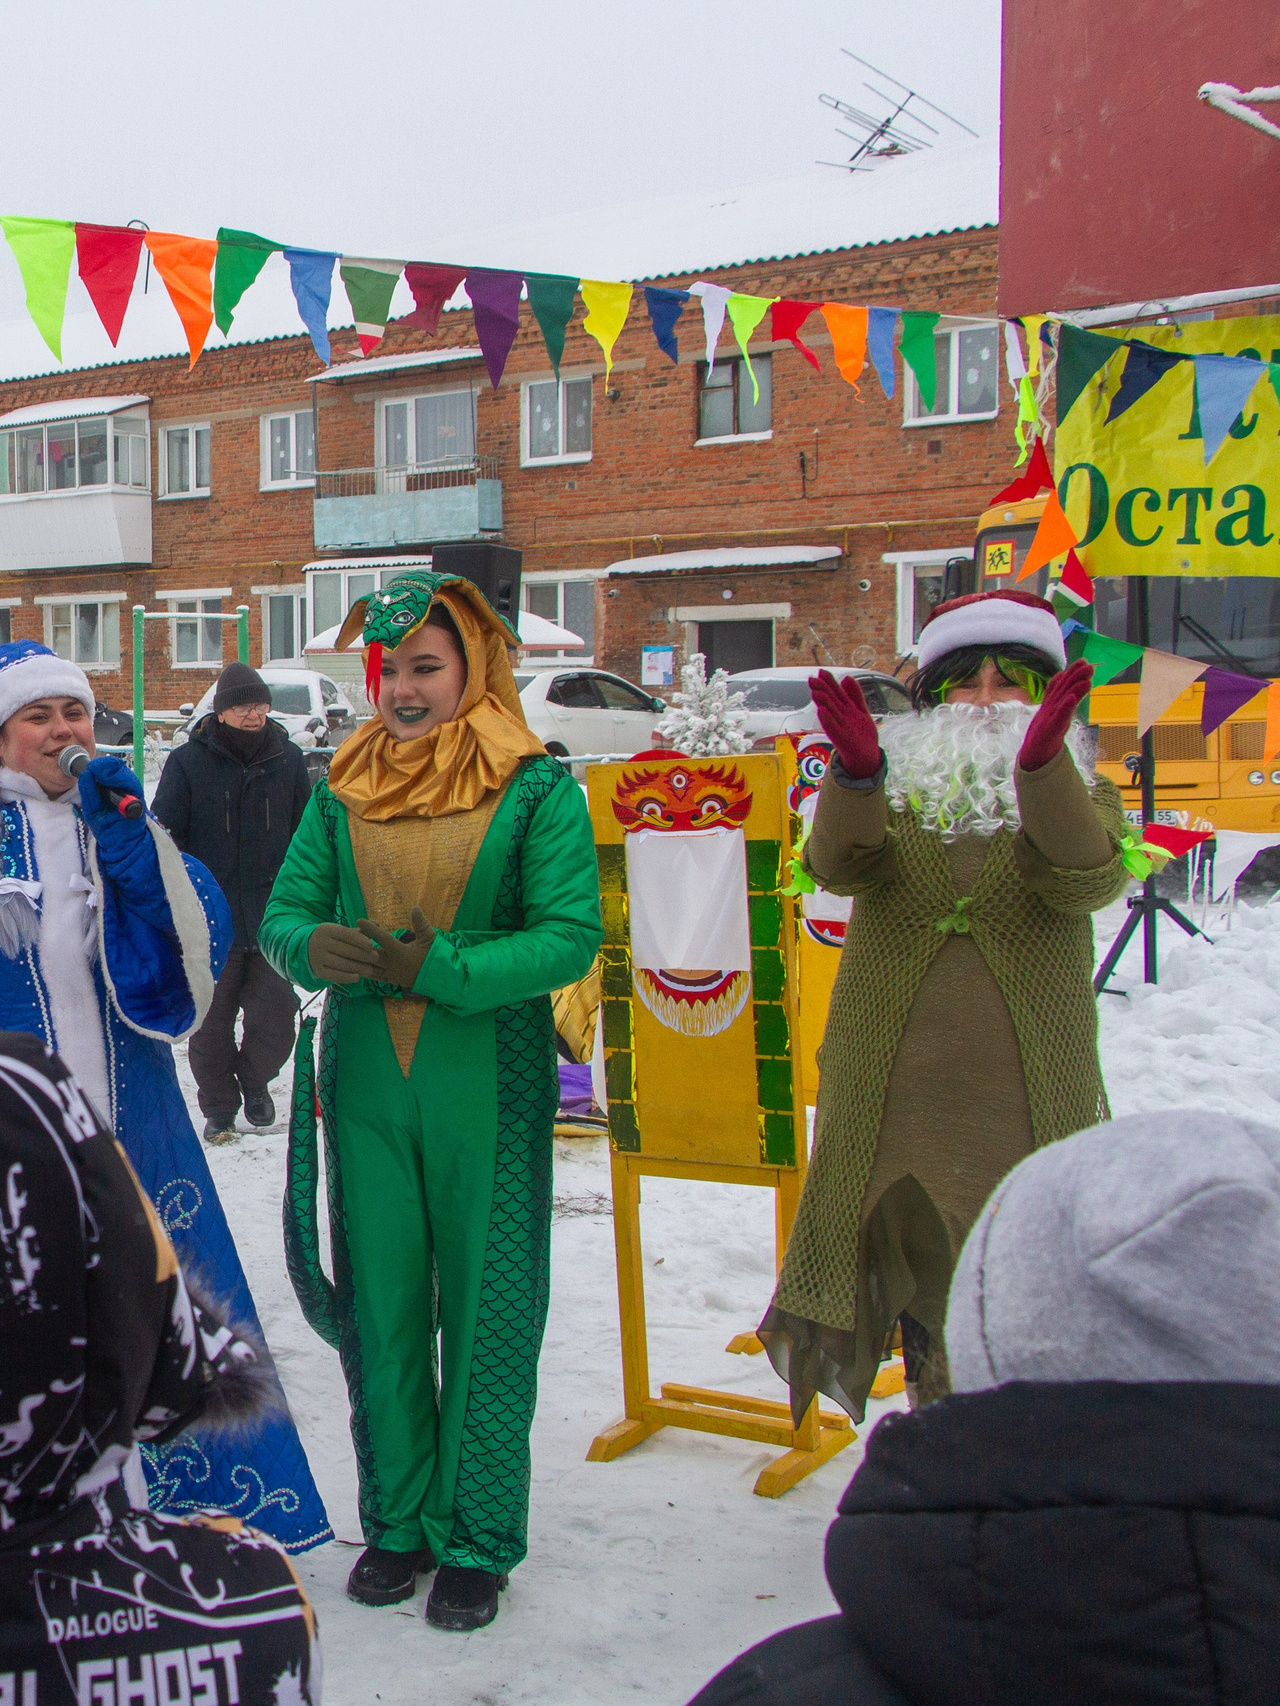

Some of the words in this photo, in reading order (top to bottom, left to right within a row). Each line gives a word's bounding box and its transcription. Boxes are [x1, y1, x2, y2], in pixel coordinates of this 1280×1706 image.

[1058, 463, 1280, 547] Оста
[47, 1607, 159, 1644] DALOGUE
[76, 1639, 243, 1706] GHOST
